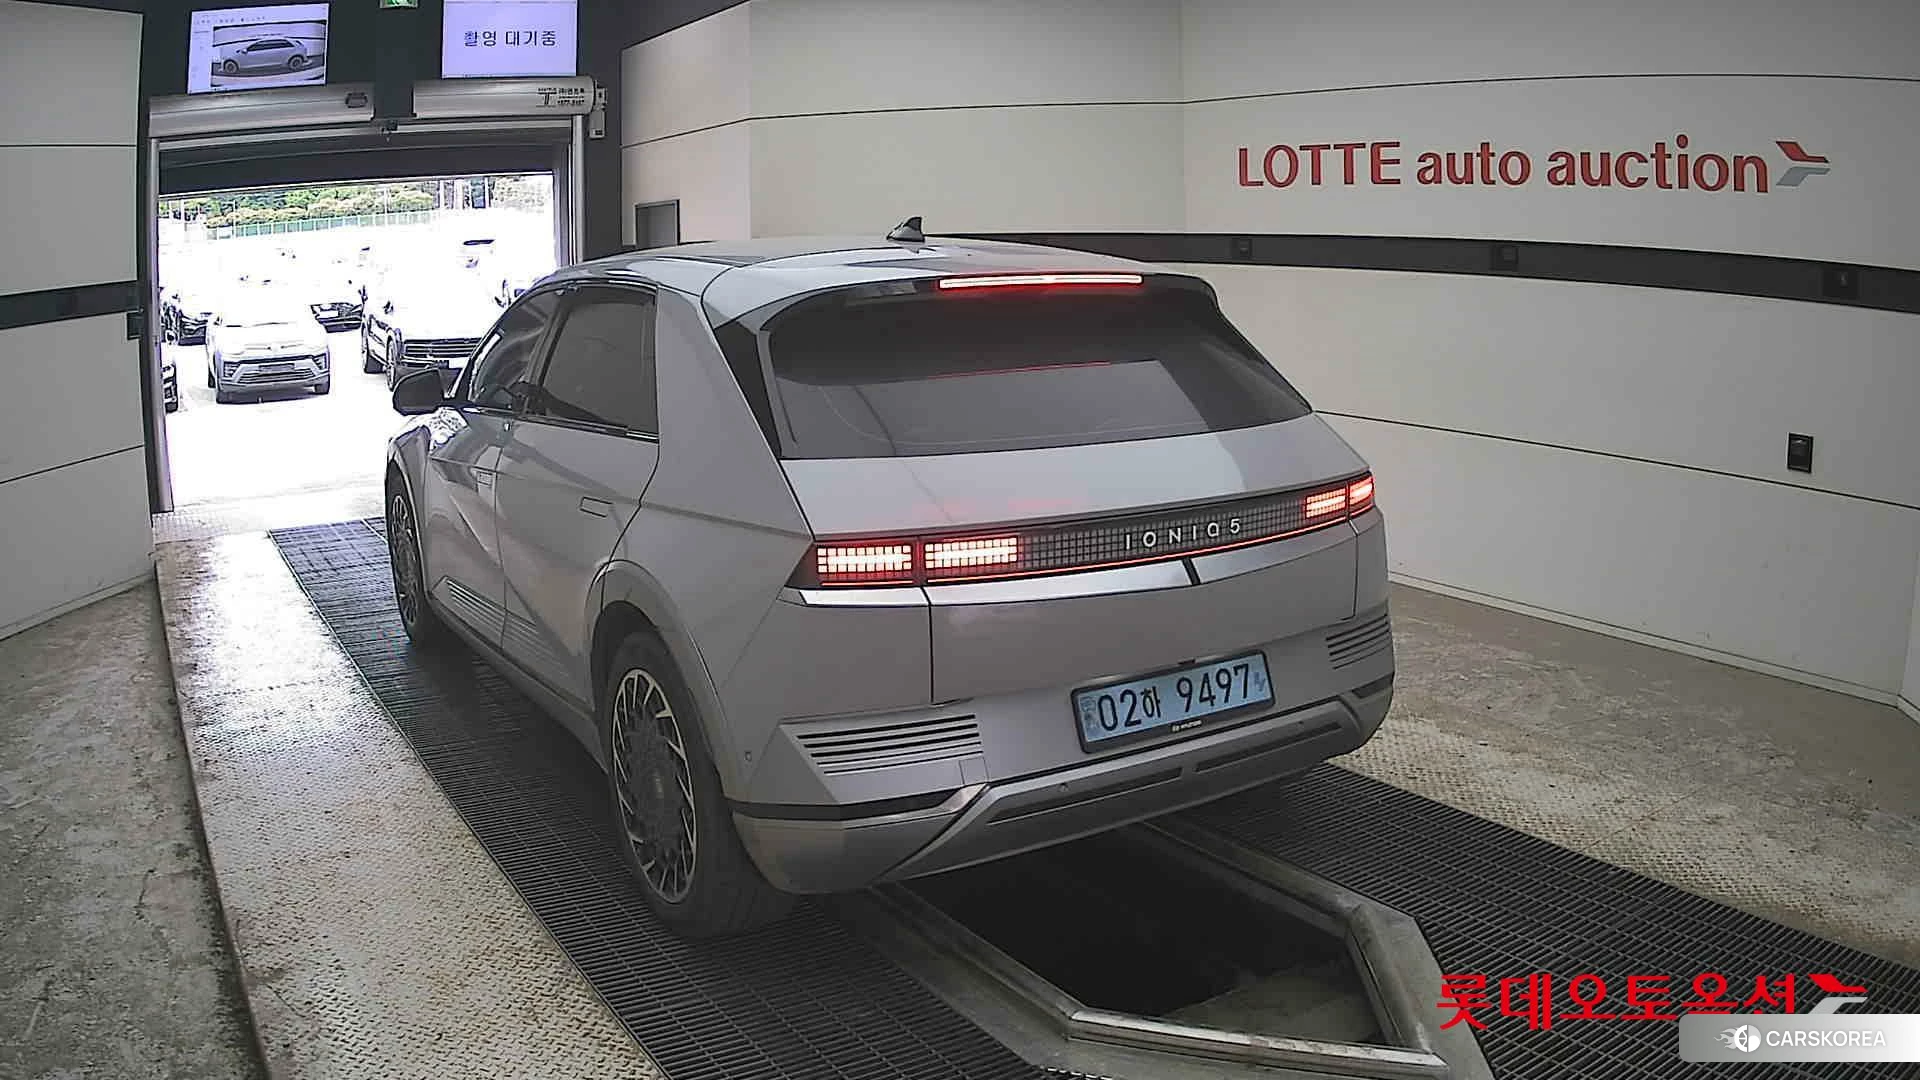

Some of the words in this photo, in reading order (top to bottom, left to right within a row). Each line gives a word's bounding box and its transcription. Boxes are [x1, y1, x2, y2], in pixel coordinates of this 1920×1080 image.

[505, 30, 556, 46] 대기중
[1239, 141, 1401, 188] LOTTE
[1417, 142, 1531, 187] auto
[1547, 134, 1769, 194] auction
[1098, 686, 1161, 731] 02하
[1176, 663, 1250, 713] 9497
